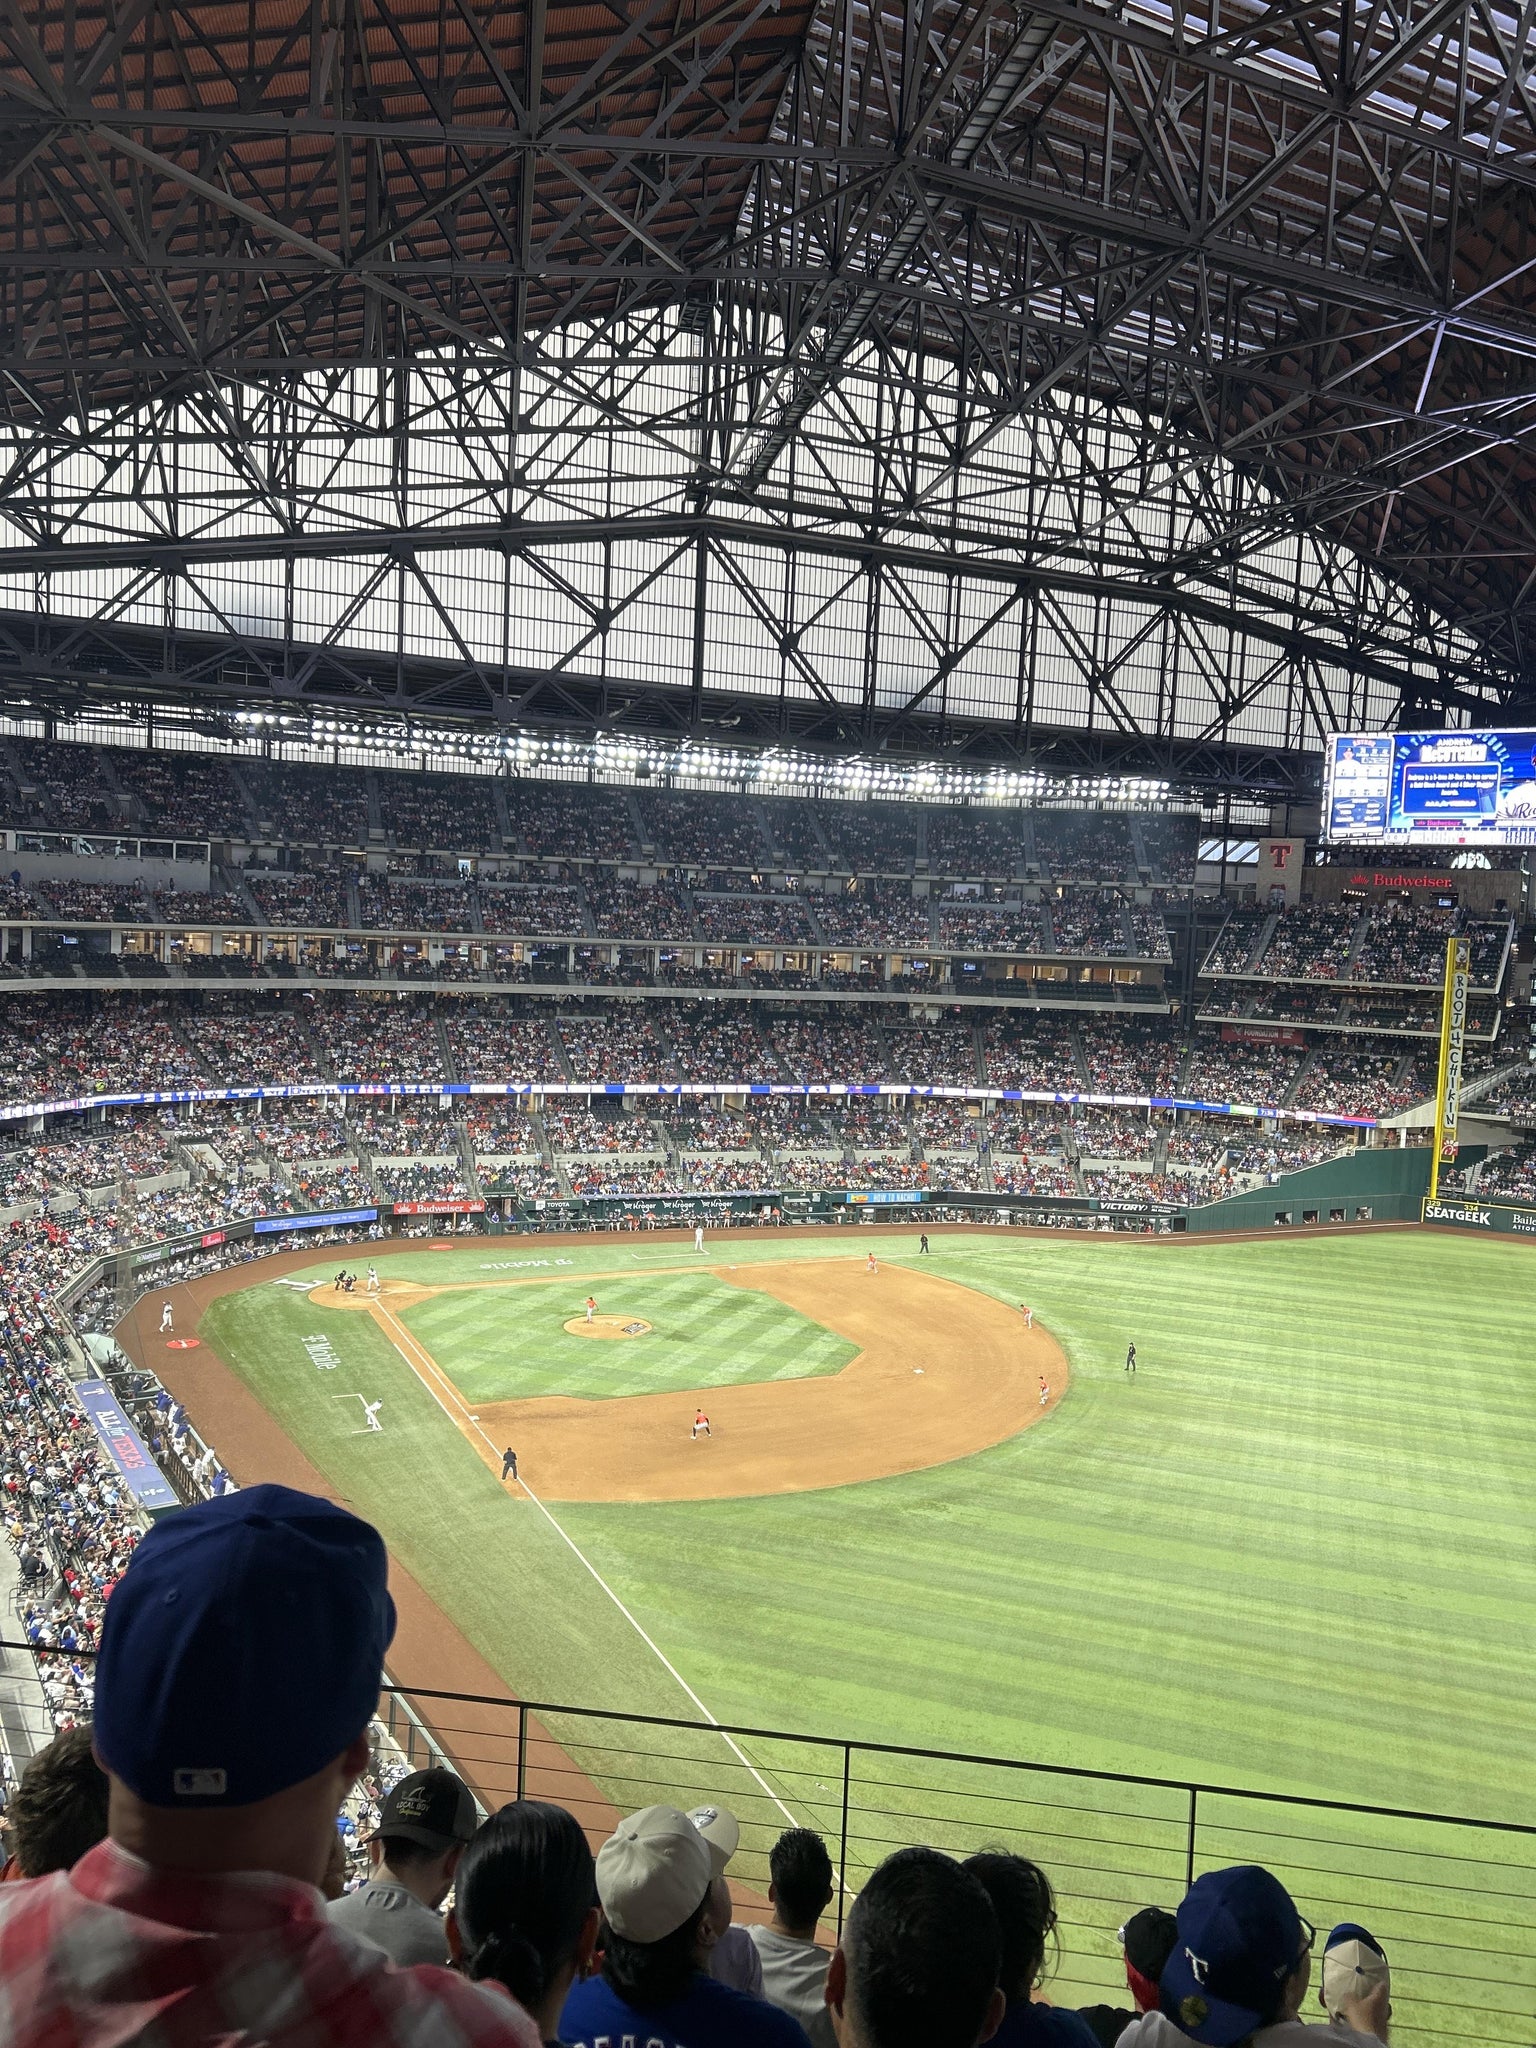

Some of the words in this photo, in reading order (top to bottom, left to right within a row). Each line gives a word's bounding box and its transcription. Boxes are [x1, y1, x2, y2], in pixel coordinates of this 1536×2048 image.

[1270, 844, 1293, 869] T
[1373, 874, 1451, 887] Budweiser
[1452, 975, 1464, 1024] ROOT
[1451, 1032, 1461, 1045] 4
[1446, 1051, 1459, 1125] CHIKIN
[417, 1204, 464, 1213] Budweiser
[633, 1201, 656, 1212] Kroger
[672, 1200, 695, 1212] Kroger
[710, 1200, 734, 1211] Kroger
[1100, 1202, 1145, 1211] VICTORY
[1425, 1206, 1491, 1225] SEATGEEK
[141, 1250, 162, 1260] National
[304, 1342, 342, 1370] Mobile
[95, 1410, 122, 1429] ALL
[111, 1435, 146, 1469] TEXAS
